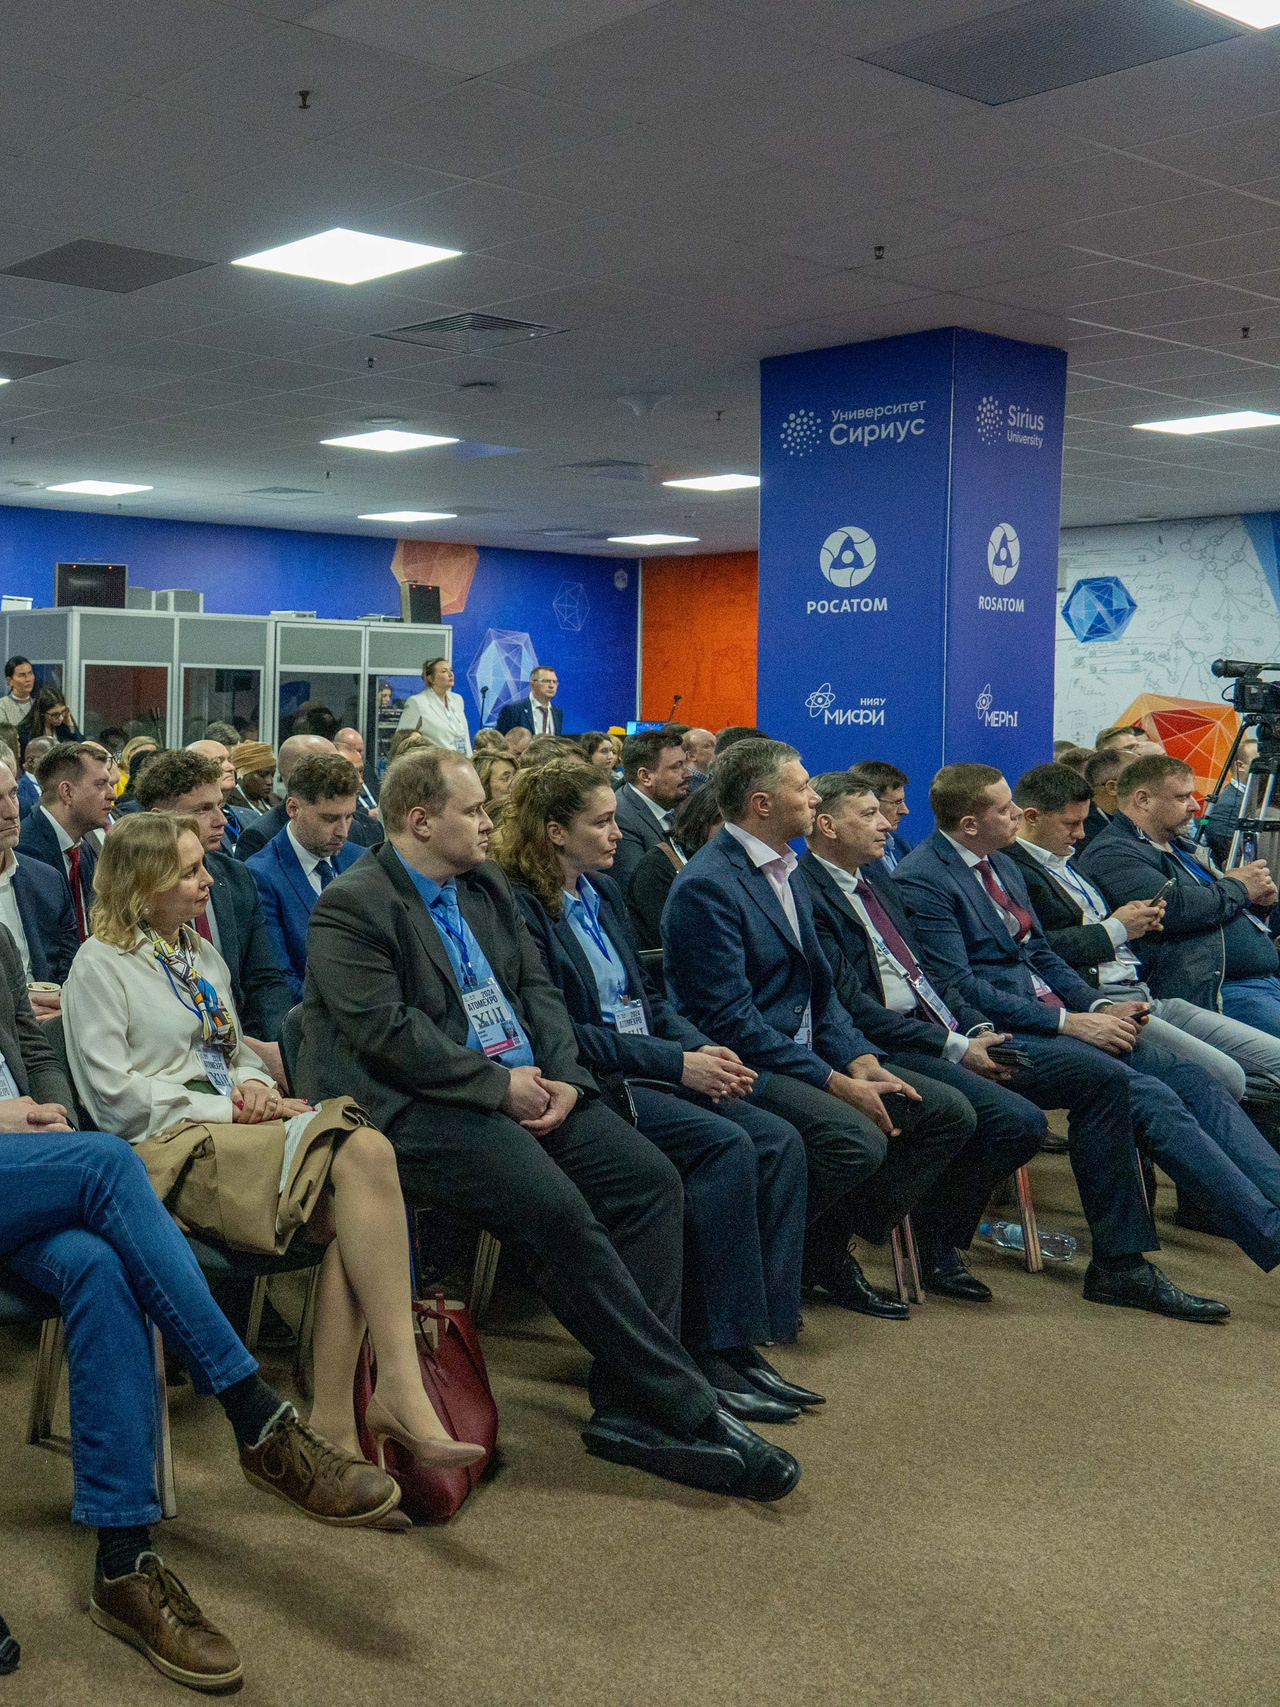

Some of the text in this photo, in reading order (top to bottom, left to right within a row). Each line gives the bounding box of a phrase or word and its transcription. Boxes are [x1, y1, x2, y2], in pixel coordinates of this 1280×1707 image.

[831, 400, 926, 423] Университет
[1008, 404, 1044, 431] Sirius
[829, 417, 926, 446] Сириус
[1007, 430, 1043, 448] University
[806, 598, 888, 614] РОСАТОМ
[978, 596, 1025, 613] ROSATOM
[860, 697, 886, 706] НИЯУ
[824, 708, 885, 726] МИФИ
[985, 711, 1018, 727] MEPhI
[480, 988, 495, 998] 2024
[467, 995, 499, 1012] ATOMEXPO
[630, 1010, 641, 1018] 2024
[619, 1017, 642, 1029] ATOMEXPO
